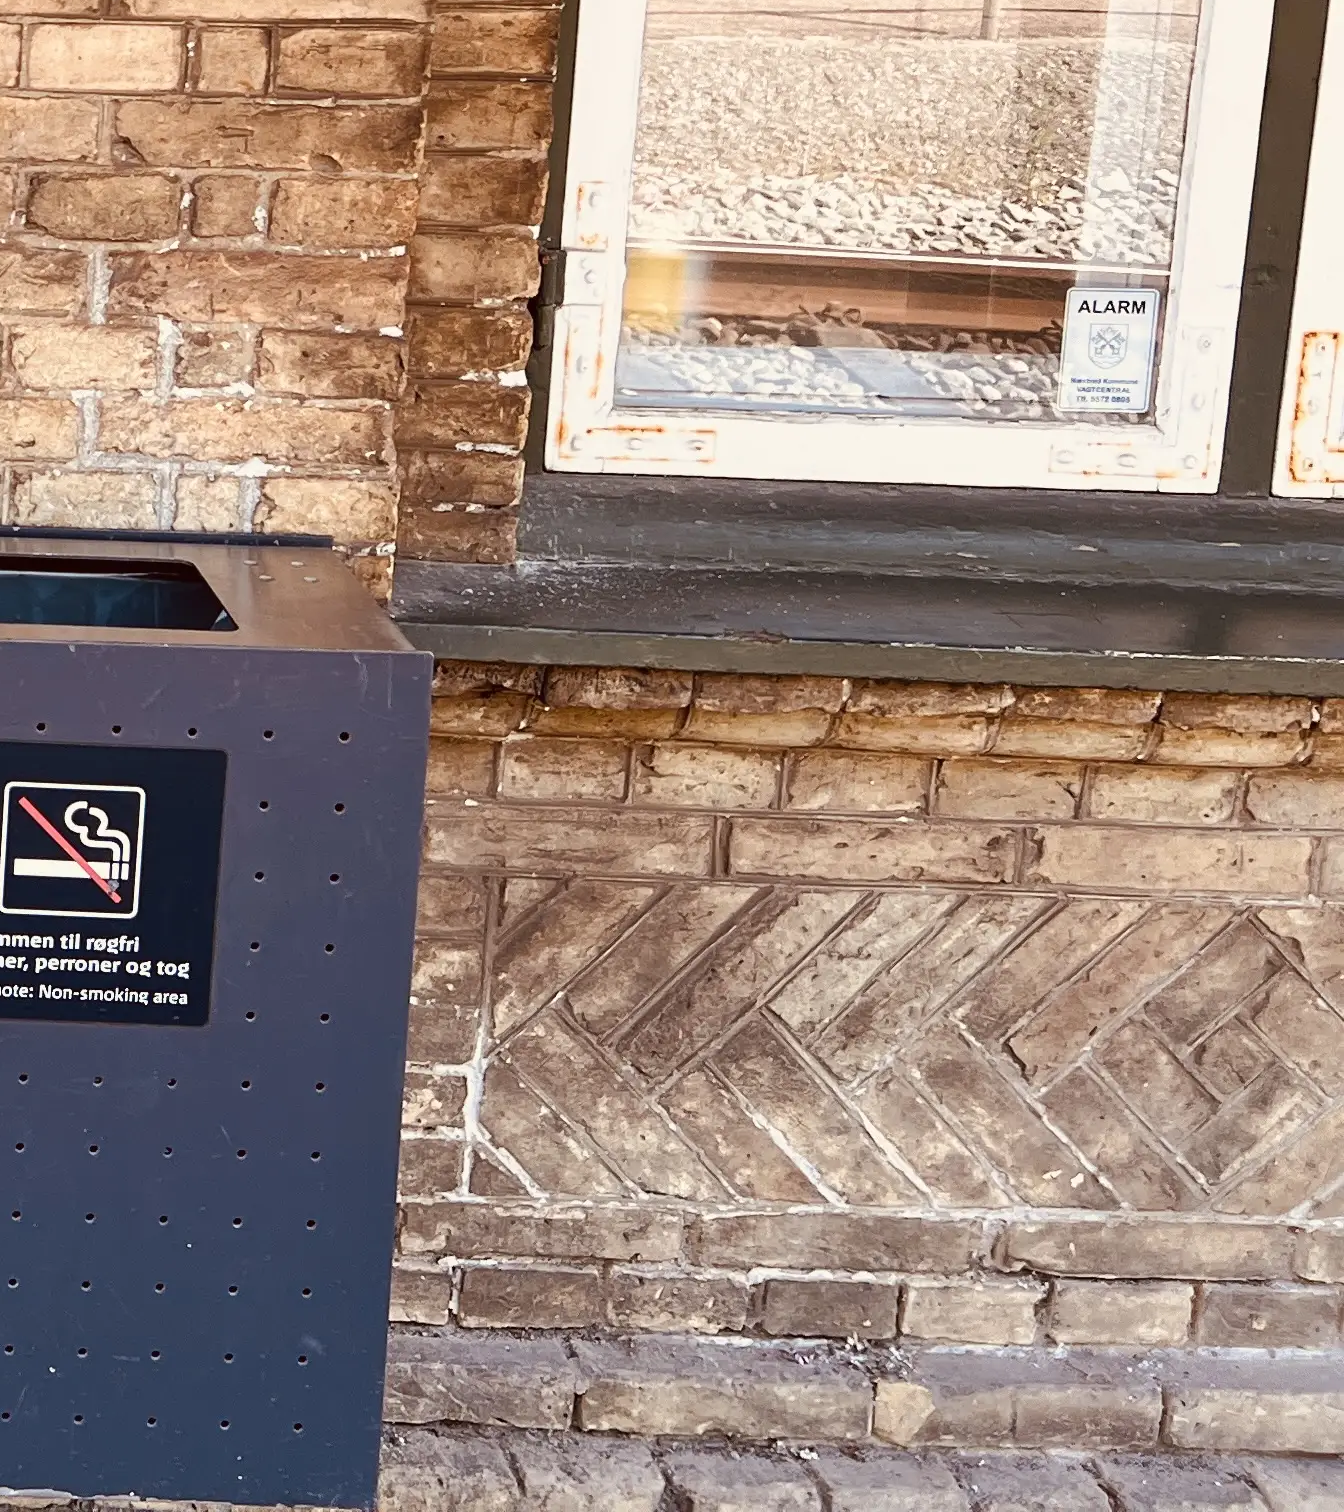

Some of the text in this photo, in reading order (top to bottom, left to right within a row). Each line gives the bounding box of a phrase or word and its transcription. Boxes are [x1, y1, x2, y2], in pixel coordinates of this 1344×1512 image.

[1077, 299, 1146, 315] ALARM
[59, 932, 81, 950] til
[85, 934, 140, 955] røgfri
[34, 956, 122, 974] perroner
[125, 960, 152, 978] og
[155, 960, 190, 980] tog
[38, 984, 149, 1006] Non-smoking
[152, 992, 189, 1005] area
